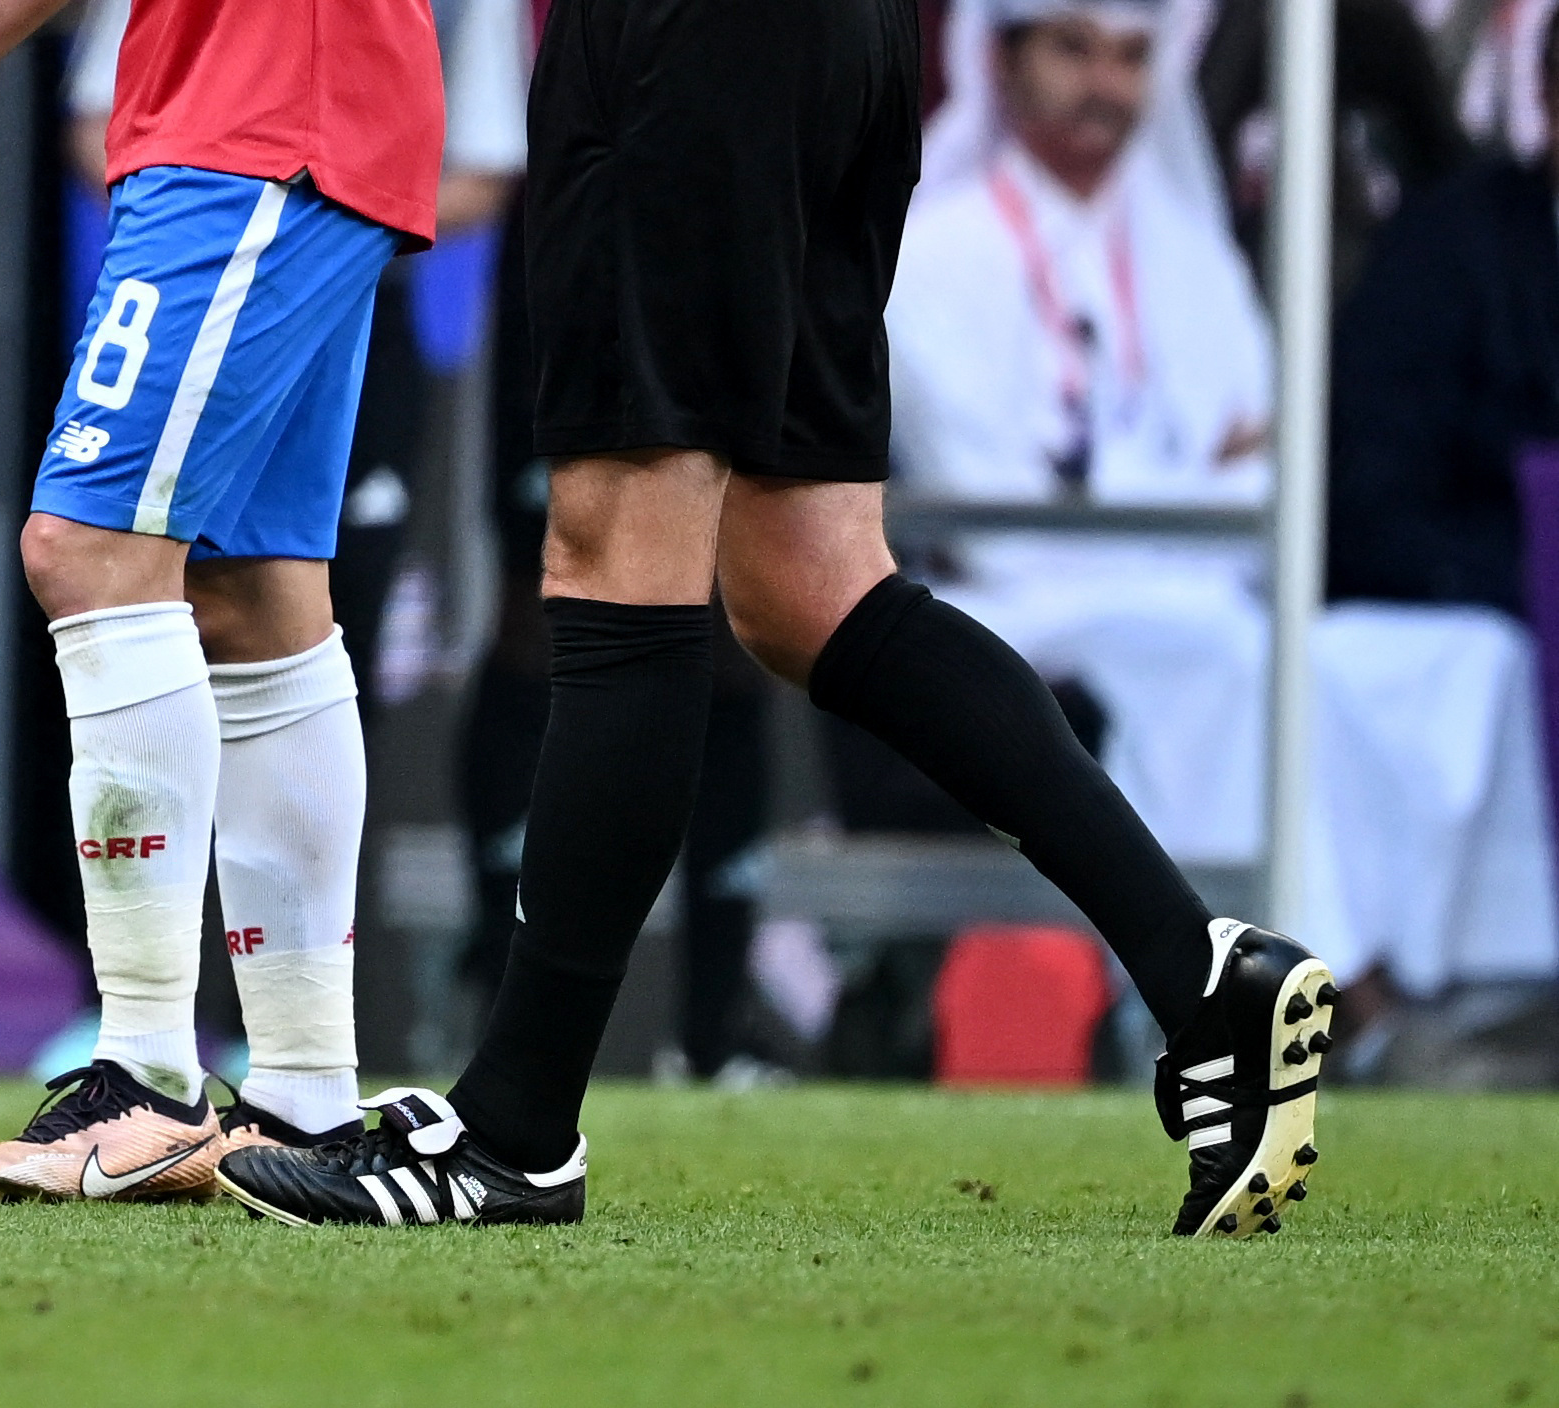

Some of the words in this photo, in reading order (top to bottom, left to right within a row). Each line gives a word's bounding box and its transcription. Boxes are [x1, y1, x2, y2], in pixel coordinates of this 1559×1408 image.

[76, 278, 160, 410] 8
[77, 835, 166, 860] CRF
[226, 926, 265, 957] RF
